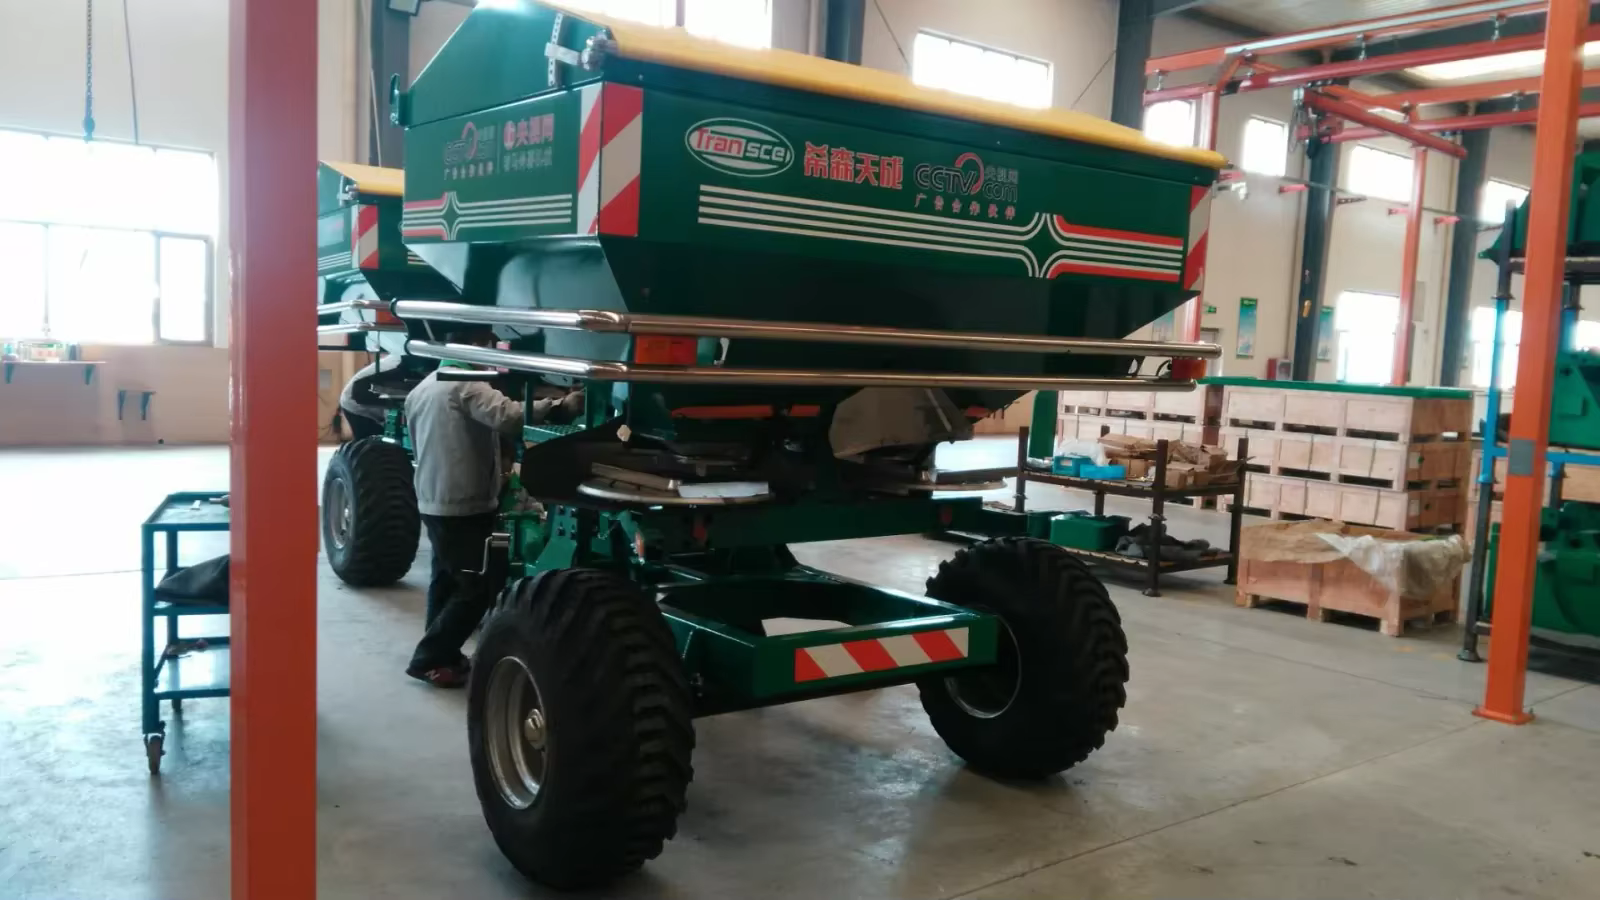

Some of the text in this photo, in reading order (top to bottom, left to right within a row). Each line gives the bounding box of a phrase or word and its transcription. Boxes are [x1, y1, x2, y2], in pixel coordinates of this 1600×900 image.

[804, 140, 904, 189] 希森天成
[914, 163, 977, 195] CCTV
